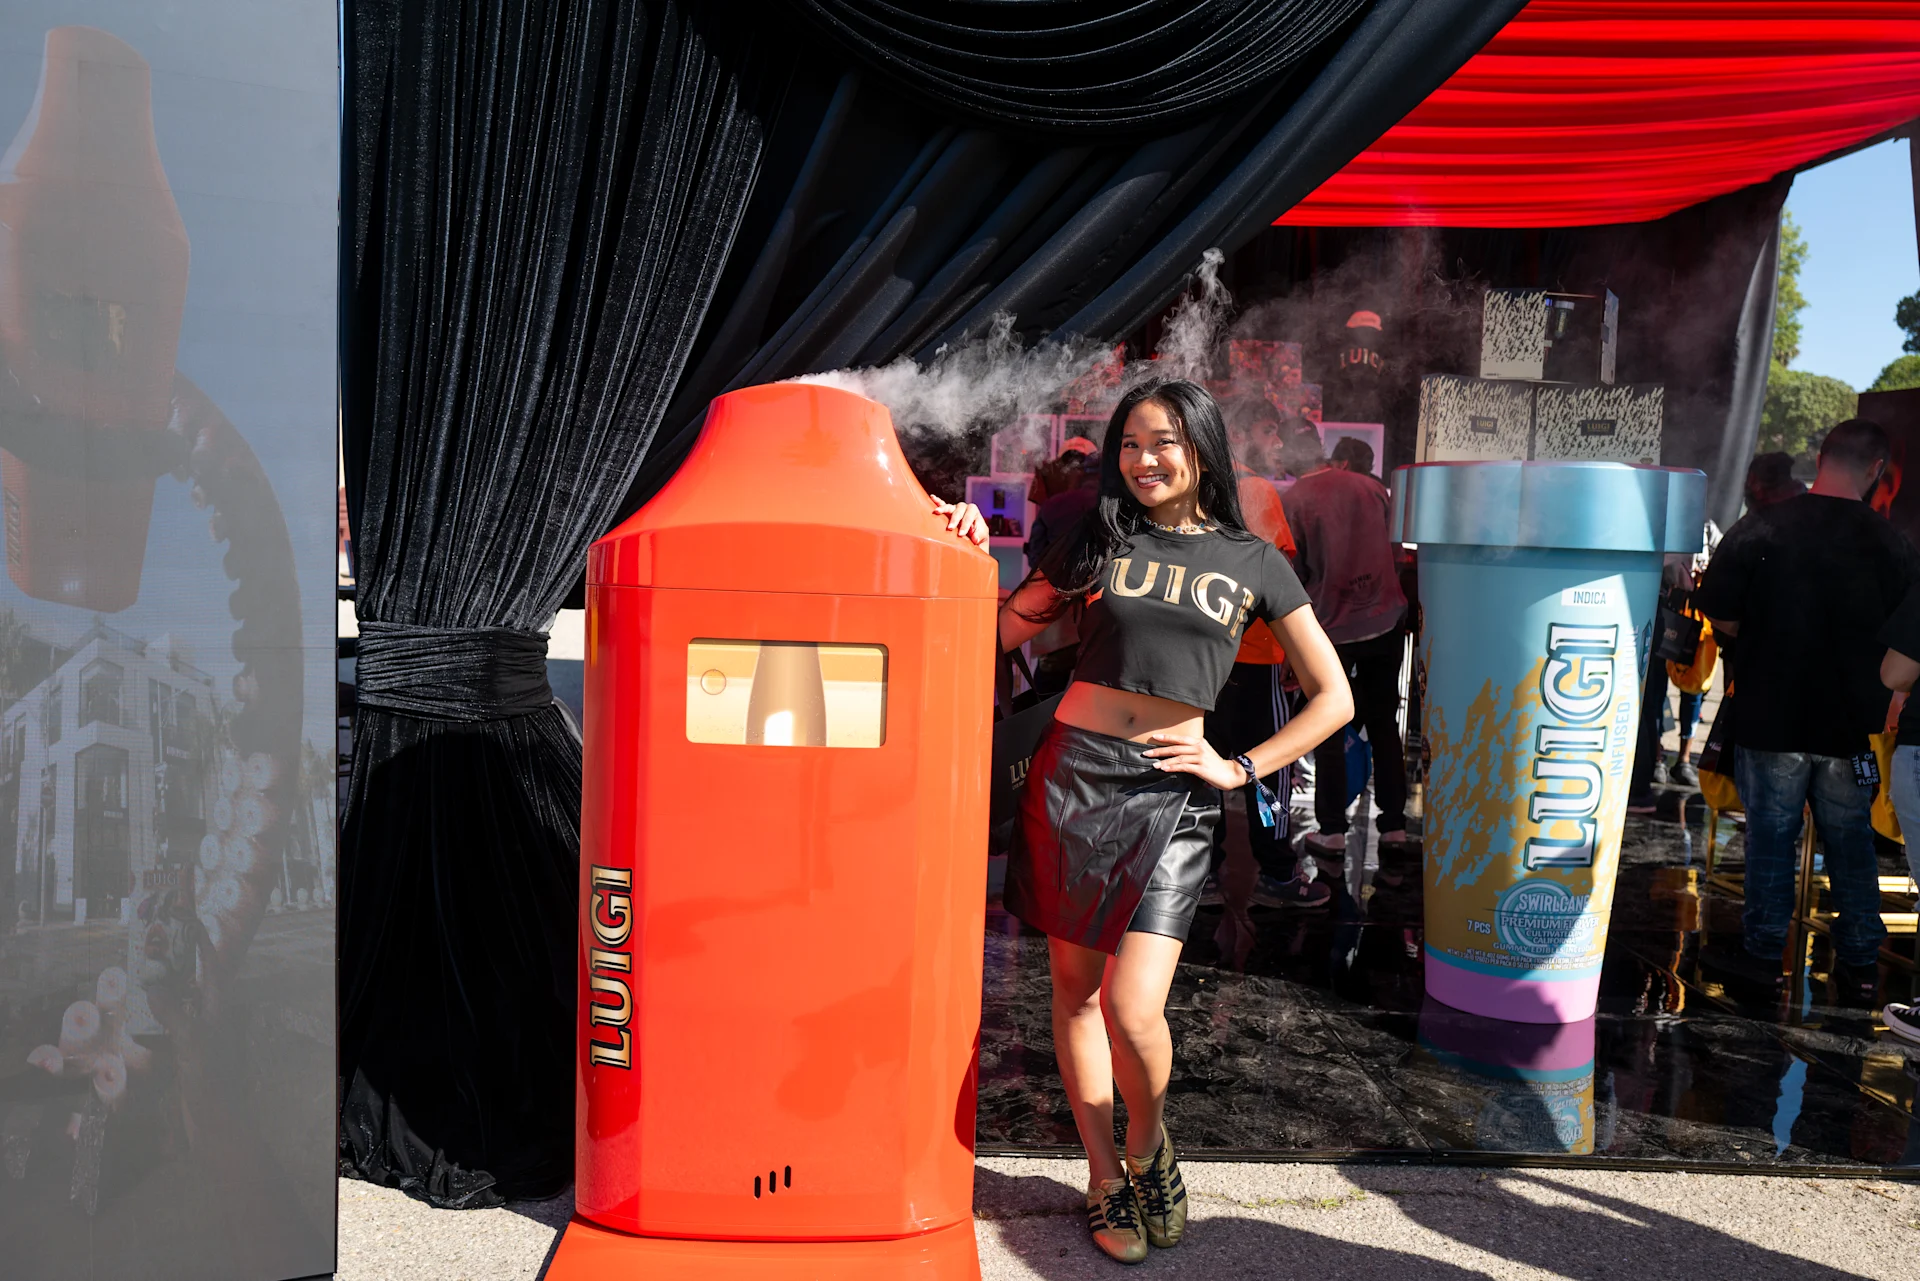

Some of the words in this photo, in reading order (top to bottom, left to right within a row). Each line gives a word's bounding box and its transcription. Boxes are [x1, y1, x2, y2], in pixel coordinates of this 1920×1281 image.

[1573, 591, 1606, 605] INDICA
[1523, 622, 1619, 871] LUIGI
[1610, 702, 1631, 777] INFUSED
[1852, 755, 1862, 775] HALL
[1467, 919, 1473, 931] 7
[1474, 921, 1491, 935] PCS
[1501, 916, 1560, 930] PREMIUM
[1562, 916, 1599, 930] FLOWER
[1492, 942, 1529, 952] GUMMY
[1531, 945, 1564, 954] EDIBLES
[1533, 937, 1576, 945] CALIFORNIA
[590, 863, 633, 1070] LUIGI
